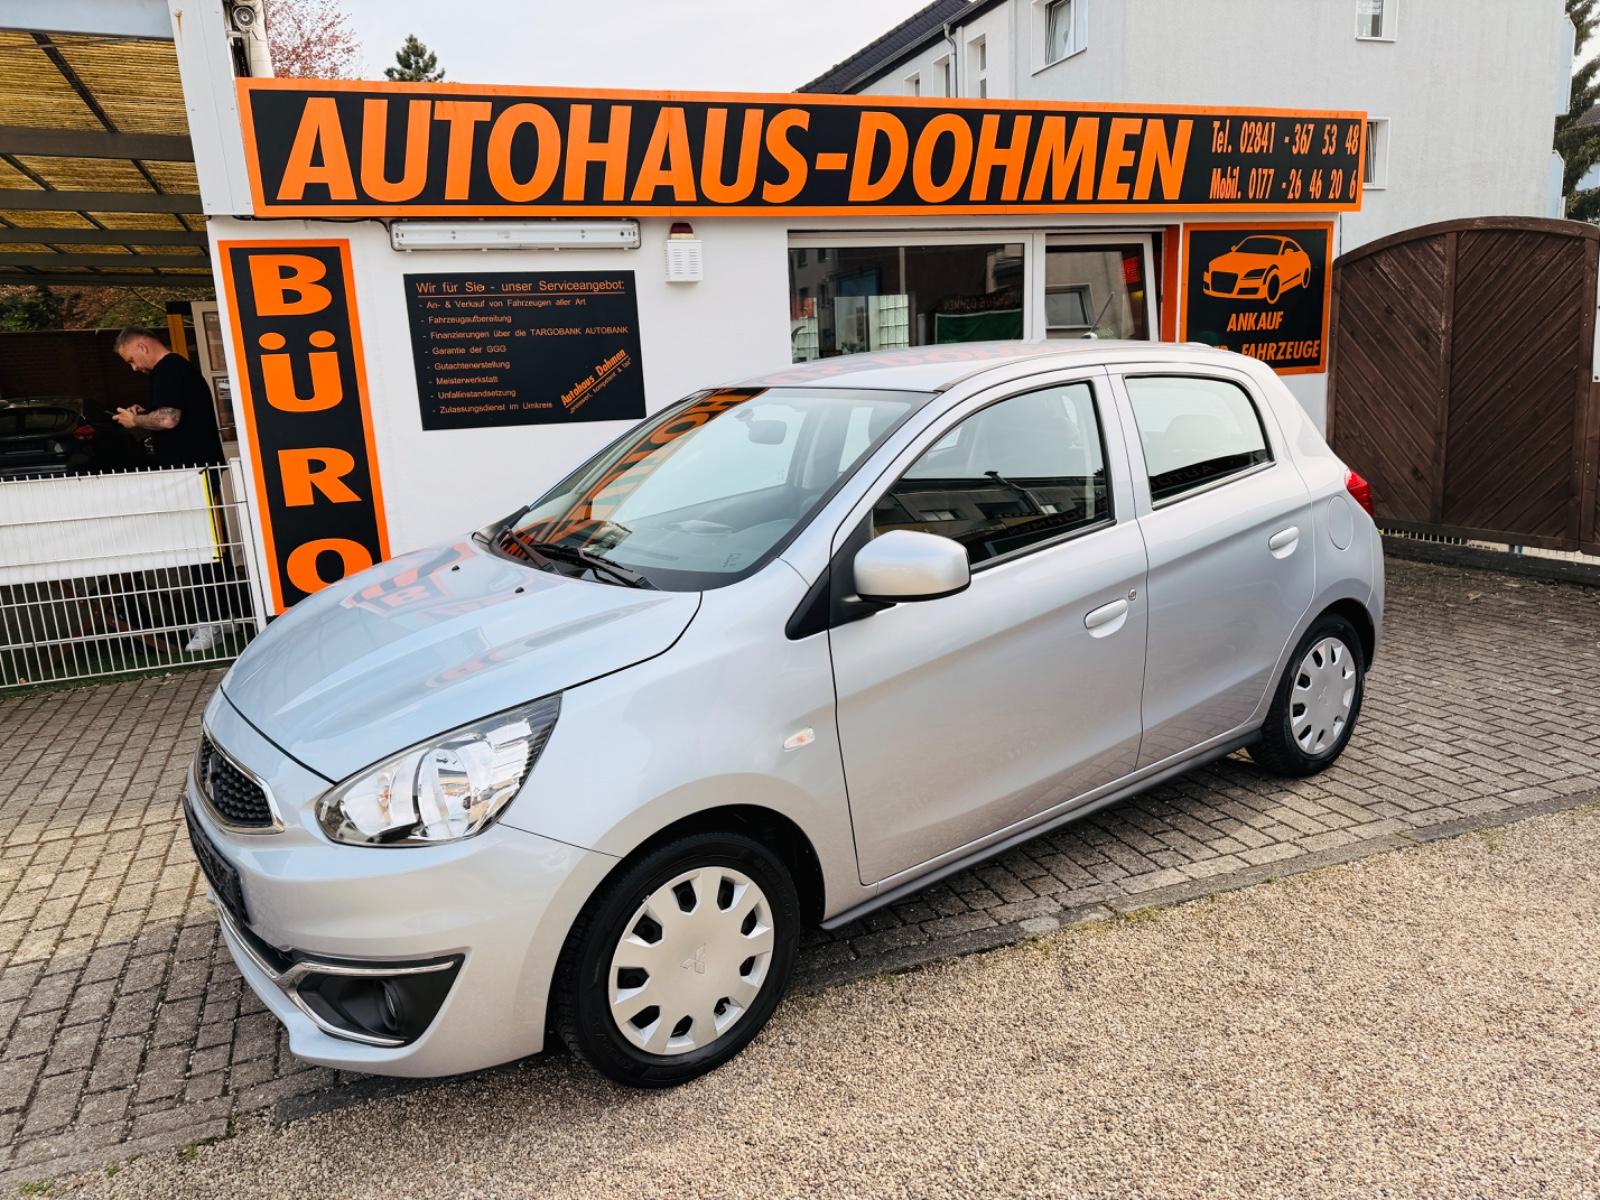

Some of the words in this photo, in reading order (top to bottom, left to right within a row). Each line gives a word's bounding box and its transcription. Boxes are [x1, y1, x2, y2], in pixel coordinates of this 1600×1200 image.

[1211, 119, 1232, 153] Tel.
[1240, 121, 1276, 154] 02841
[1322, 124, 1338, 155] 53
[1345, 124, 1360, 155] 48
[276, 96, 1194, 204] AUTOHAUS-DOHMEN
[1209, 166, 1242, 199] Mobil.
[1248, 167, 1275, 199] 0177
[1309, 169, 1323, 199] 46
[1328, 169, 1343, 199] 20
[1349, 169, 1357, 200] 6
[416, 282, 436, 293] Wir
[443, 281, 459, 293] für
[465, 281, 485, 293] Sie
[501, 280, 533, 292] unser
[539, 279, 625, 292] Serviceangebot:
[426, 301, 441, 309] An-
[444, 301, 452, 309] &
[455, 300, 485, 308] Verkauf
[507, 299, 552, 307] Fahrzeugen
[556, 298, 571, 306] aller
[575, 298, 587, 306] Art
[428, 315, 513, 325] Fahrzeugaufbereitung
[1226, 310, 1284, 332] ANKAUF
[430, 331, 490, 340] Finanzierungen
[493, 329, 511, 338] über
[514, 329, 527, 337] die
[530, 327, 582, 336] TARGOBANK
[585, 326, 629, 335] AUTOBANK
[432, 347, 466, 355] Garantie
[469, 346, 482, 354] der
[486, 345, 507, 353] GGG
[1241, 340, 1321, 361] FAHRZEUGE
[434, 361, 511, 371] Gutachtenerstellung
[436, 376, 499, 385] Meisterwerkstatt
[560, 374, 596, 406] Autohaus
[595, 349, 627, 376] Dohmen
[438, 389, 517, 399] Unfallinstandsetzung
[440, 403, 506, 414] Zulassungsdienst
[509, 402, 519, 410] im
[523, 401, 553, 410] Umkreis
[248, 254, 373, 594] BÜRO
